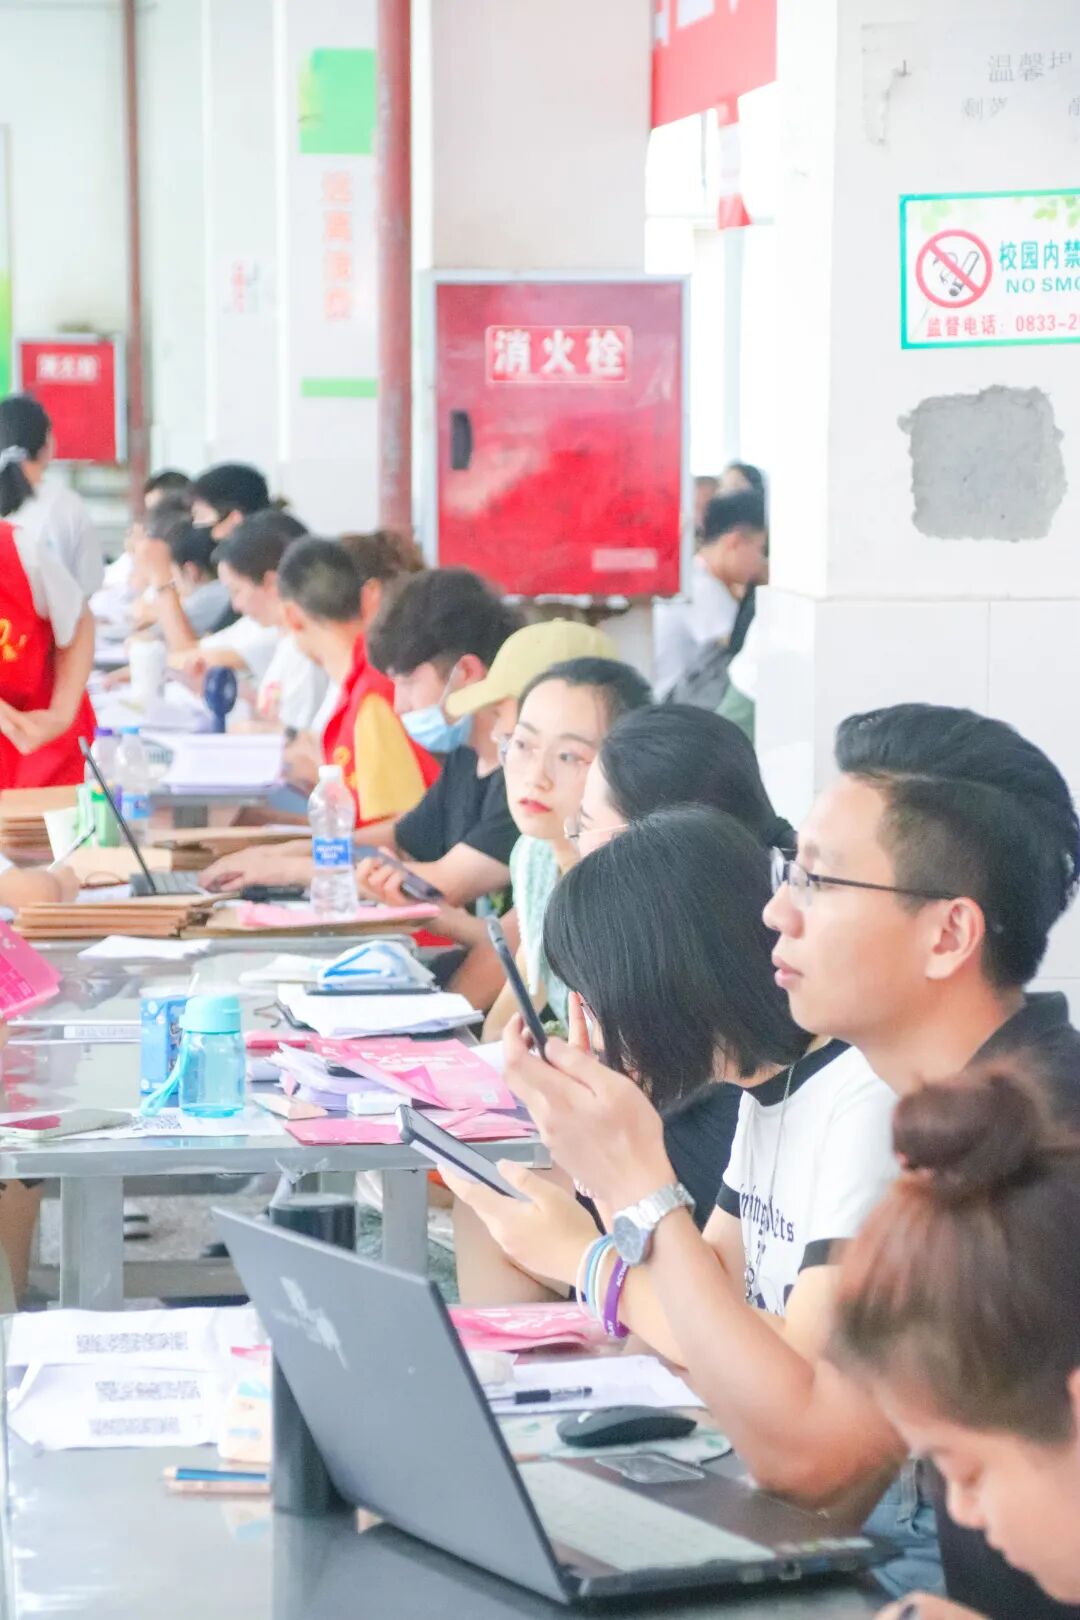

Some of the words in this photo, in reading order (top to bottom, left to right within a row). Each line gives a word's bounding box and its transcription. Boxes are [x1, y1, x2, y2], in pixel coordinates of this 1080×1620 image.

[999, 239, 1080, 272] 校园内禁
[1006, 278, 1036, 294] NO
[1015, 313, 1080, 332] 0833-2
[494, 328, 625, 376] 消火栓
